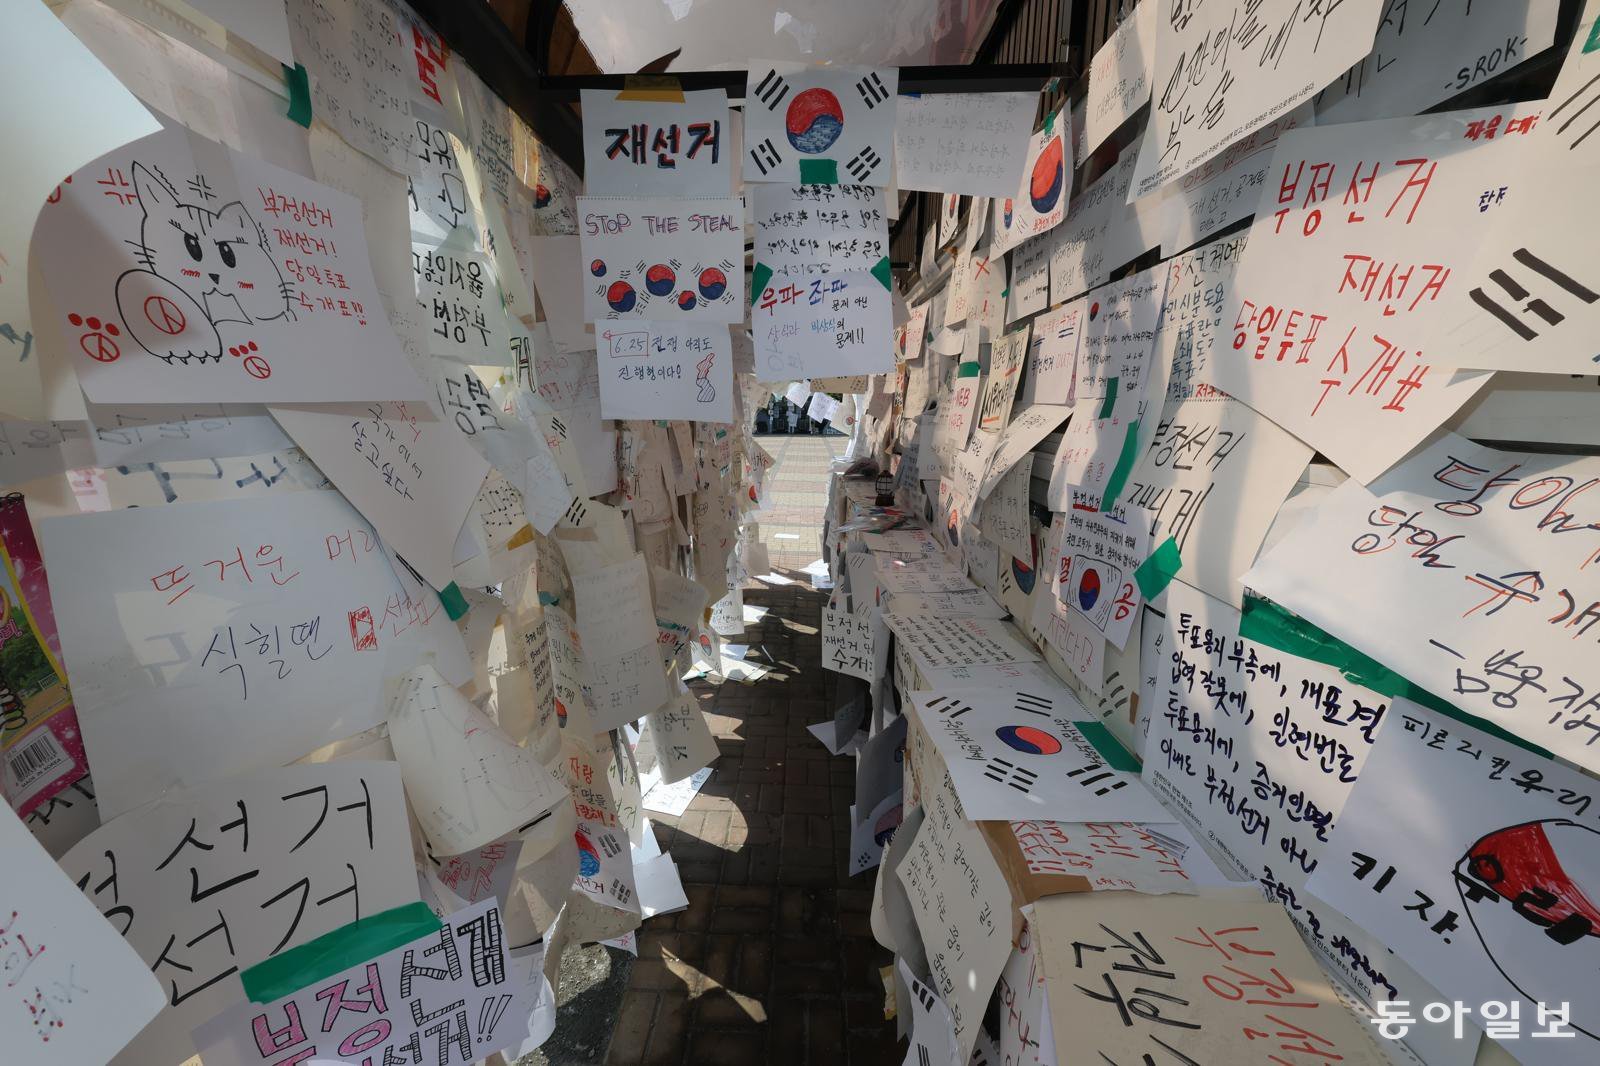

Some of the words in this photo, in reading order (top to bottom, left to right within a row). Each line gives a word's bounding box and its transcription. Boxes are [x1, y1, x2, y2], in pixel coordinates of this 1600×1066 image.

[604, 120, 721, 169] 재선거
[1464, 114, 1502, 141] 자유
[1504, 111, 1542, 135] 대
[258, 187, 333, 228] 부정선거
[1275, 158, 1438, 236] 부정선거
[273, 228, 337, 257] 재선거!
[584, 213, 632, 236] STOP
[641, 215, 680, 234] THE
[688, 213, 742, 235] STEAL
[285, 259, 352, 291] 당일투표
[760, 283, 804, 316] 우파
[1339, 254, 1451, 316] 재선거
[831, 298, 850, 311] 문제
[615, 334, 646, 354] 6.25
[652, 335, 678, 353] 전쟁
[685, 336, 713, 353] 아직도
[835, 328, 865, 349] 문제!!
[1233, 300, 1328, 364] 당일투표
[1311, 326, 1431, 417] 수개표
[352, 420, 414, 502] 살고싶다
[1148, 417, 1246, 472] 부정선거
[1108, 504, 1127, 521] 선거
[150, 543, 301, 605] 뜨거운
[1115, 583, 1136, 620] 공
[827, 613, 874, 640] 부정선
[831, 650, 874, 673] 수개
[1177, 612, 1225, 667] 투표용지
[1228, 641, 1288, 697] 부족에,
[1172, 651, 1195, 693] 입력
[1200, 670, 1254, 725] 잘못에,
[1163, 690, 1240, 773] 투표용지에,
[1160, 738, 1196, 777] 이래도
[1203, 765, 1270, 845] 부정선거
[953, 842, 980, 899] 걸어가는
[979, 902, 997, 938] 길이
[1173, 926, 1346, 1066] 부정선
